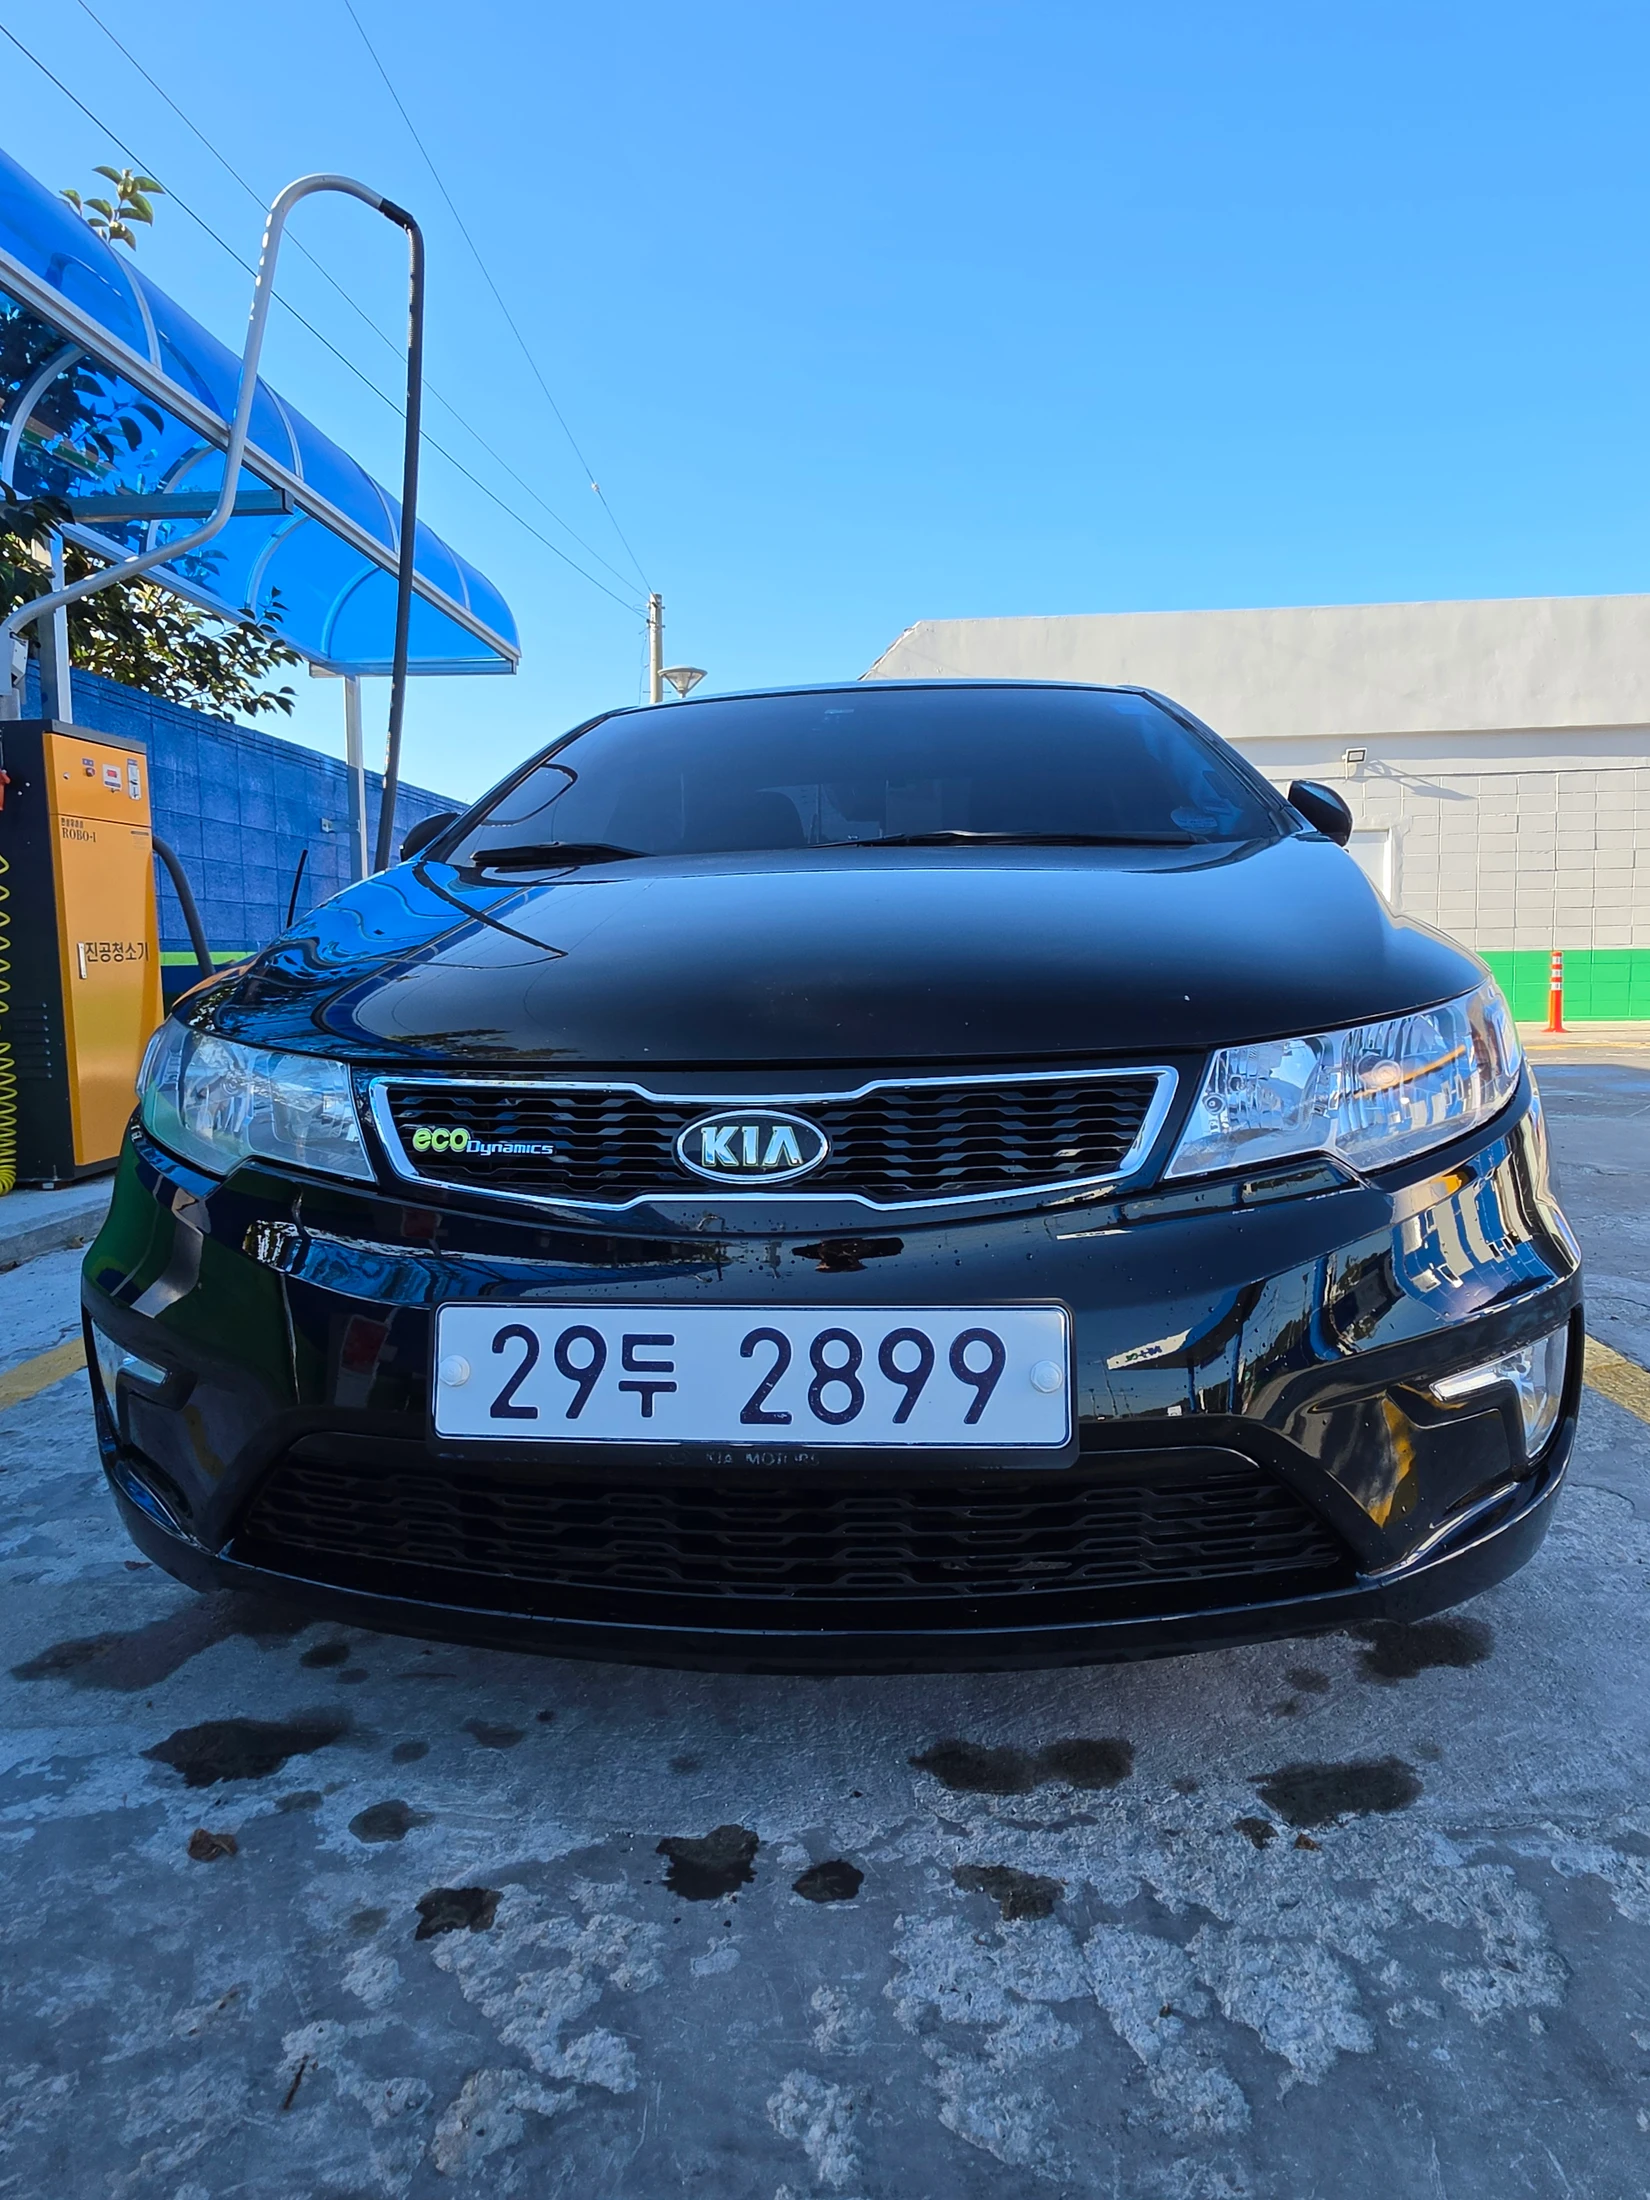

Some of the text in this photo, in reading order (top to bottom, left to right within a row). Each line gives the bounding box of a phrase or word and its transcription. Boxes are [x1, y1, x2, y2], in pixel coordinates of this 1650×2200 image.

[85, 942, 149, 962] 진공청소기
[412, 1127, 471, 1152] eco
[701, 1126, 802, 1166] KIA
[489, 1324, 1007, 1425] 29두 2899
